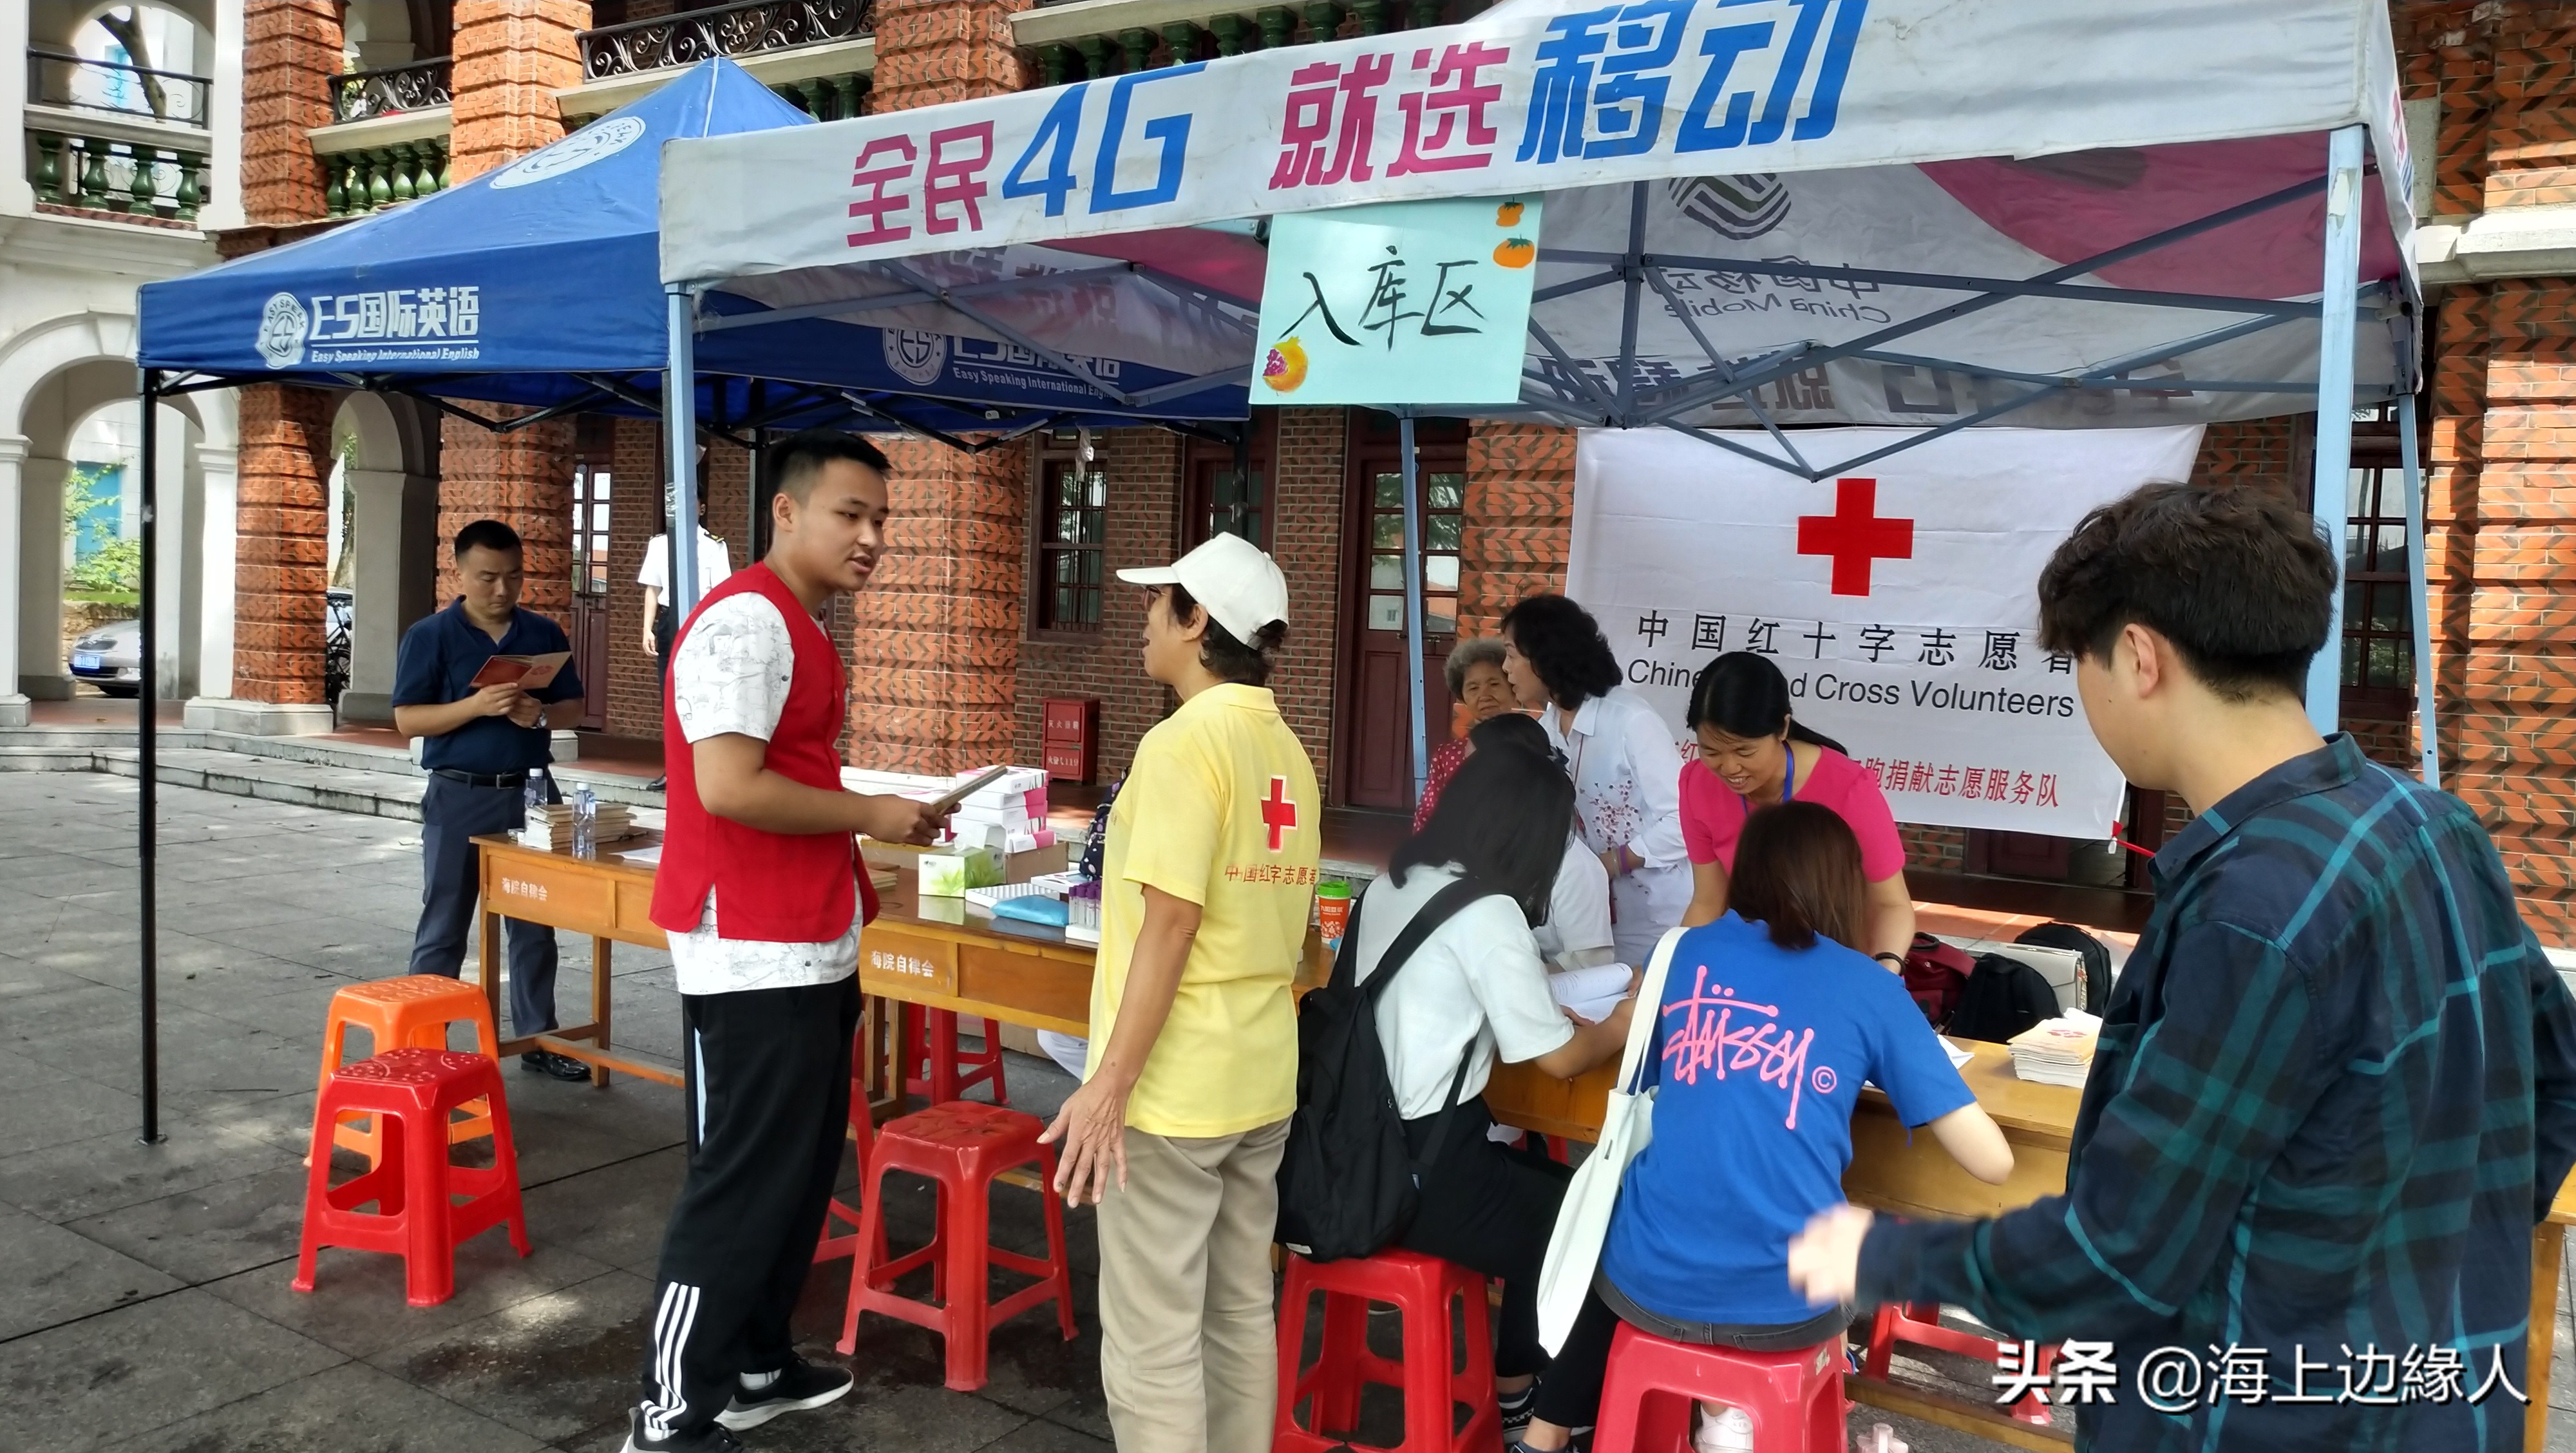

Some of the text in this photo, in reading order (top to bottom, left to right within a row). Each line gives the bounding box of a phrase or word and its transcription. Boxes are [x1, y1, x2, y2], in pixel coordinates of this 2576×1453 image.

[846, 62, 1208, 248] 全民4G
[1278, 245, 1486, 351] 入库区
[311, 347, 480, 363] Easy Speaking International English
[952, 367, 980, 383] Easy
[981, 370, 1027, 390] Speaking
[1028, 375, 1087, 395] International
[1815, 673, 1900, 705] Cross
[1911, 680, 2075, 717] Volunteers
[1851, 757, 2059, 808] 胞捐献志愿服务队
[871, 950, 934, 978] 海院自律会
